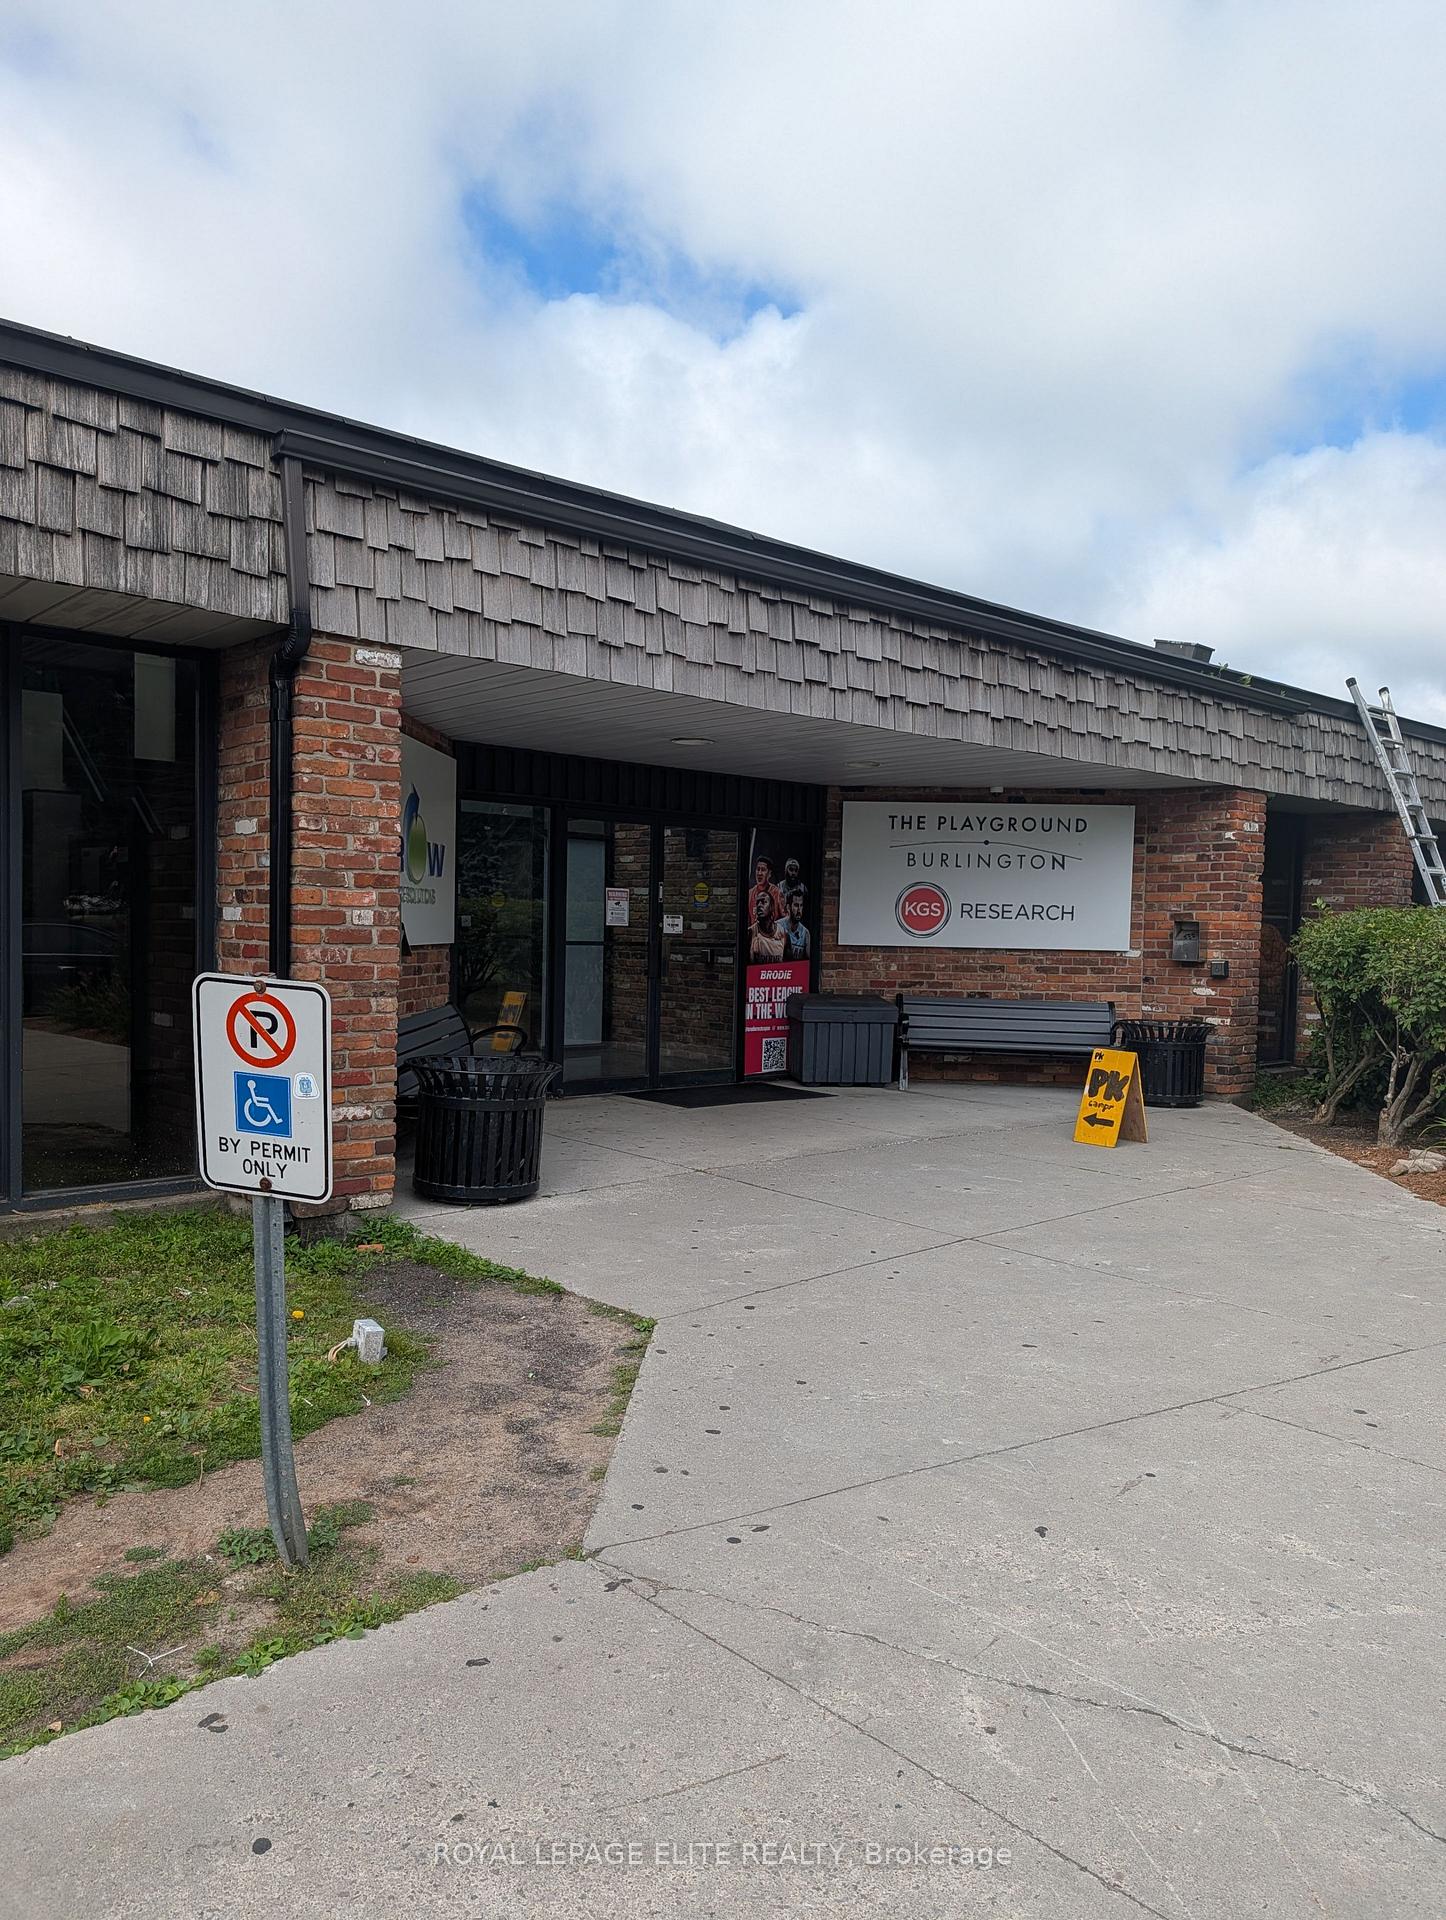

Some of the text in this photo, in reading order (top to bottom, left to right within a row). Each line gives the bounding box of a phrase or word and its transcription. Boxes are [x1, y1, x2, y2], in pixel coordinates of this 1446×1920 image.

[888, 815, 1088, 833] THE PLAYGROUND
[907, 852, 1066, 871] BURLINGTON
[904, 900, 1075, 921] KGS RESEARCH
[748, 987, 770, 1003] BEST
[756, 1003, 773, 1020] THE
[219, 1136, 311, 1164] BY PERMIT
[242, 1158, 288, 1179] ONLY
